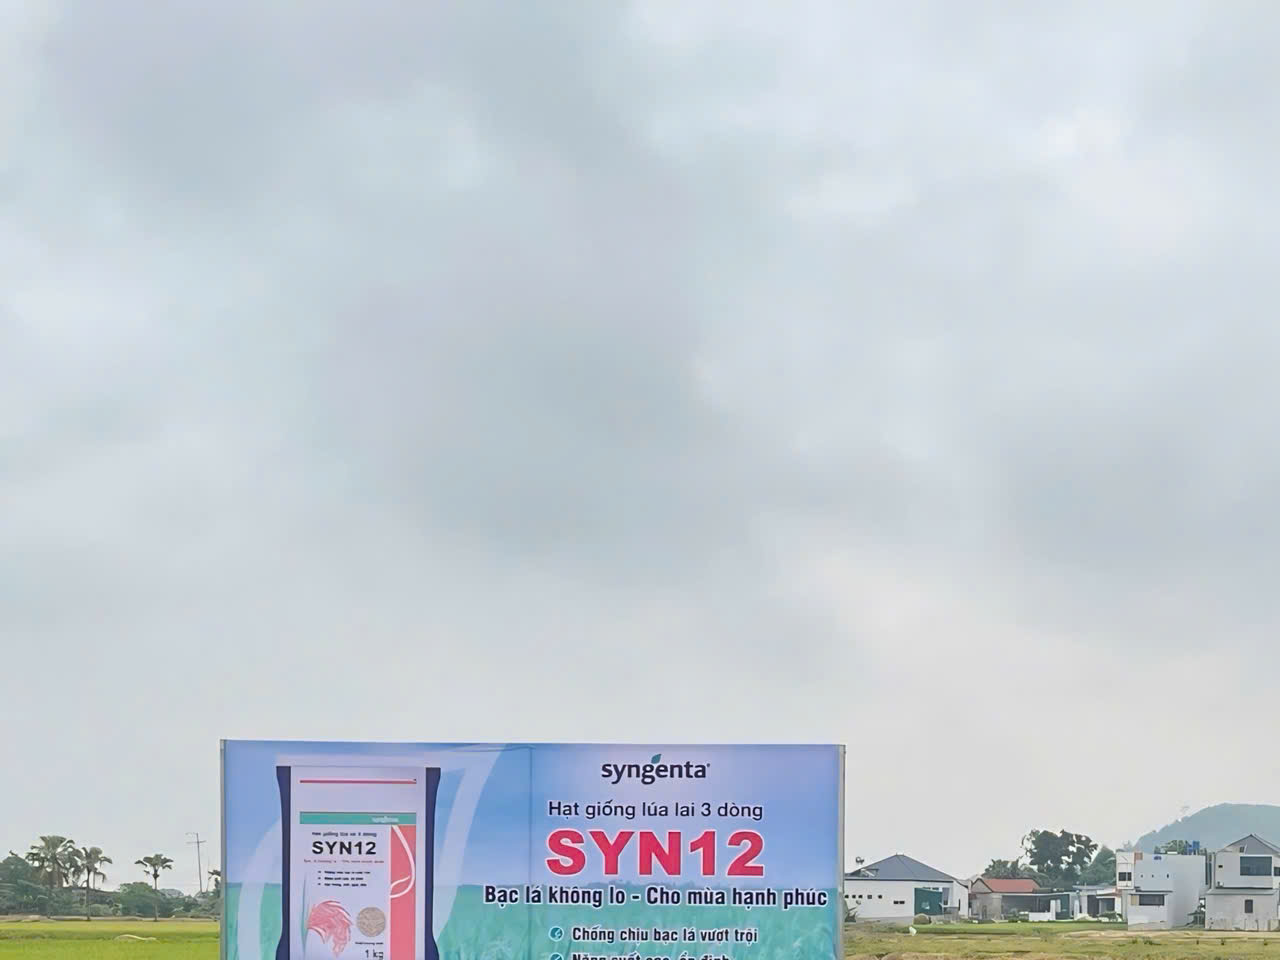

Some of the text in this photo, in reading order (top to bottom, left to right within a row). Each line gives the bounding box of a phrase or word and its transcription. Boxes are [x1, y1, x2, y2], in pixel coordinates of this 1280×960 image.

[602, 761, 707, 784] syngenta
[549, 800, 763, 820] Hạt giống lúa lai 3 dòng
[311, 841, 377, 855] SYN12
[546, 829, 764, 876] SYN12
[485, 886, 519, 907] Bạc
[525, 887, 541, 903] lá
[550, 887, 602, 907] không
[610, 887, 625, 904] lo
[647, 887, 680, 904] Cho
[688, 887, 725, 905] mùa
[732, 888, 776, 907] hạnh
[783, 888, 827, 909] phúc
[572, 926, 758, 946] Chống chịu bạc lá vượt trội
